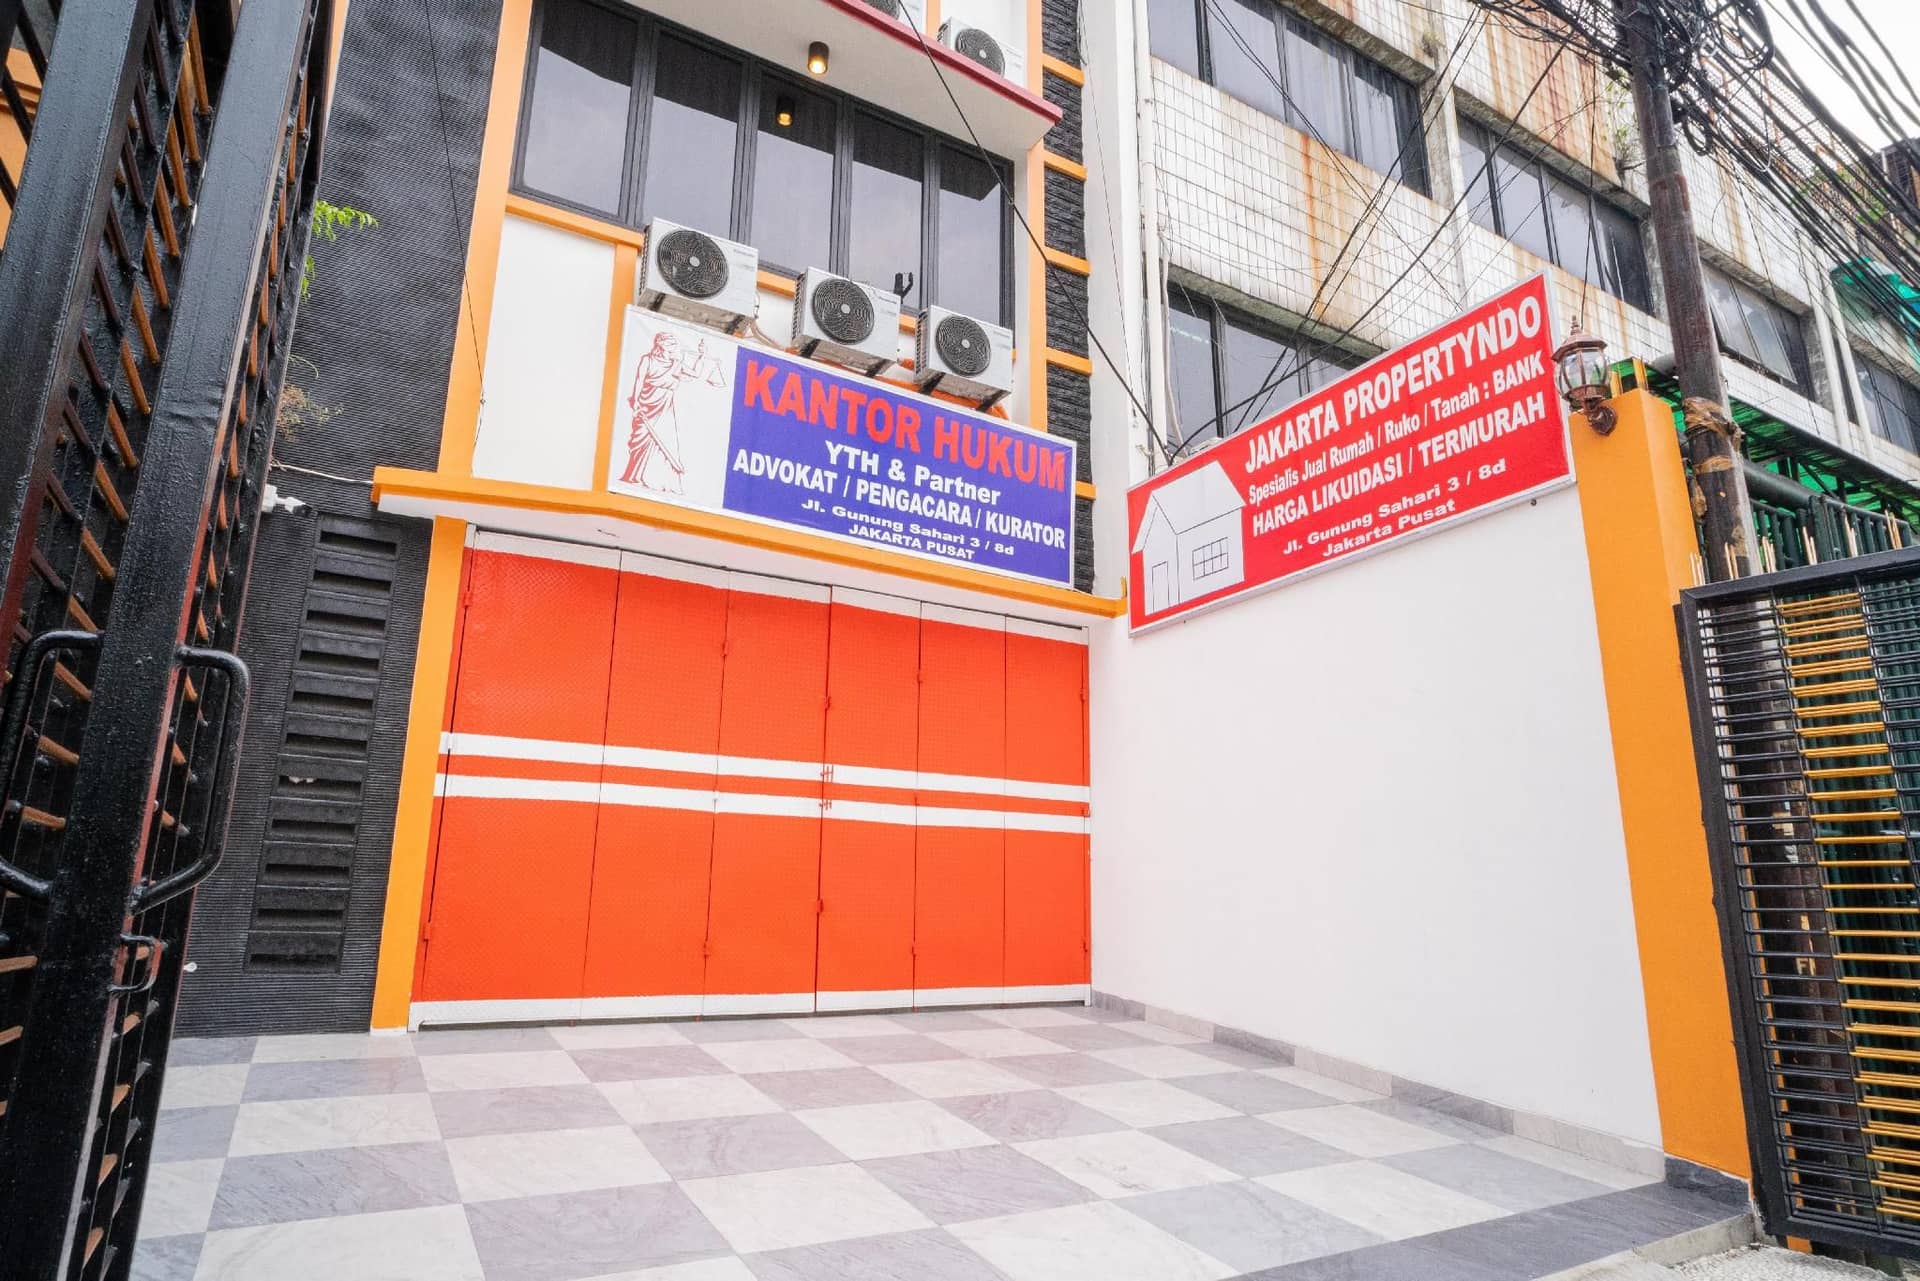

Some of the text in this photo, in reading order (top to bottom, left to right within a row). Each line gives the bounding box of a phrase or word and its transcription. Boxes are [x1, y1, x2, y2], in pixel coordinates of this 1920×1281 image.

[744, 360, 1065, 491] KANTOR HUKUM
[1245, 296, 1541, 473] JAKARTA PROPERTYNDO
[1249, 350, 1545, 507] Spesialis Jual Rumah / Ruko / Tanah : BANK
[733, 449, 1066, 549] ADVOKAT / PENGACARA / KURATOR
[825, 440, 1001, 505] YTH & Partner
[1252, 391, 1546, 537] HARGA LIKUIDASI / TERMURAH
[1283, 458, 1506, 555] Jl. Gunung Sahari 3 / 8d
[801, 499, 1015, 555] Jl. Gunung Sahari 3 / 8d
[849, 524, 975, 560] JAKARTA PUSAT
[1323, 499, 1456, 557] Jakarta Pusat
